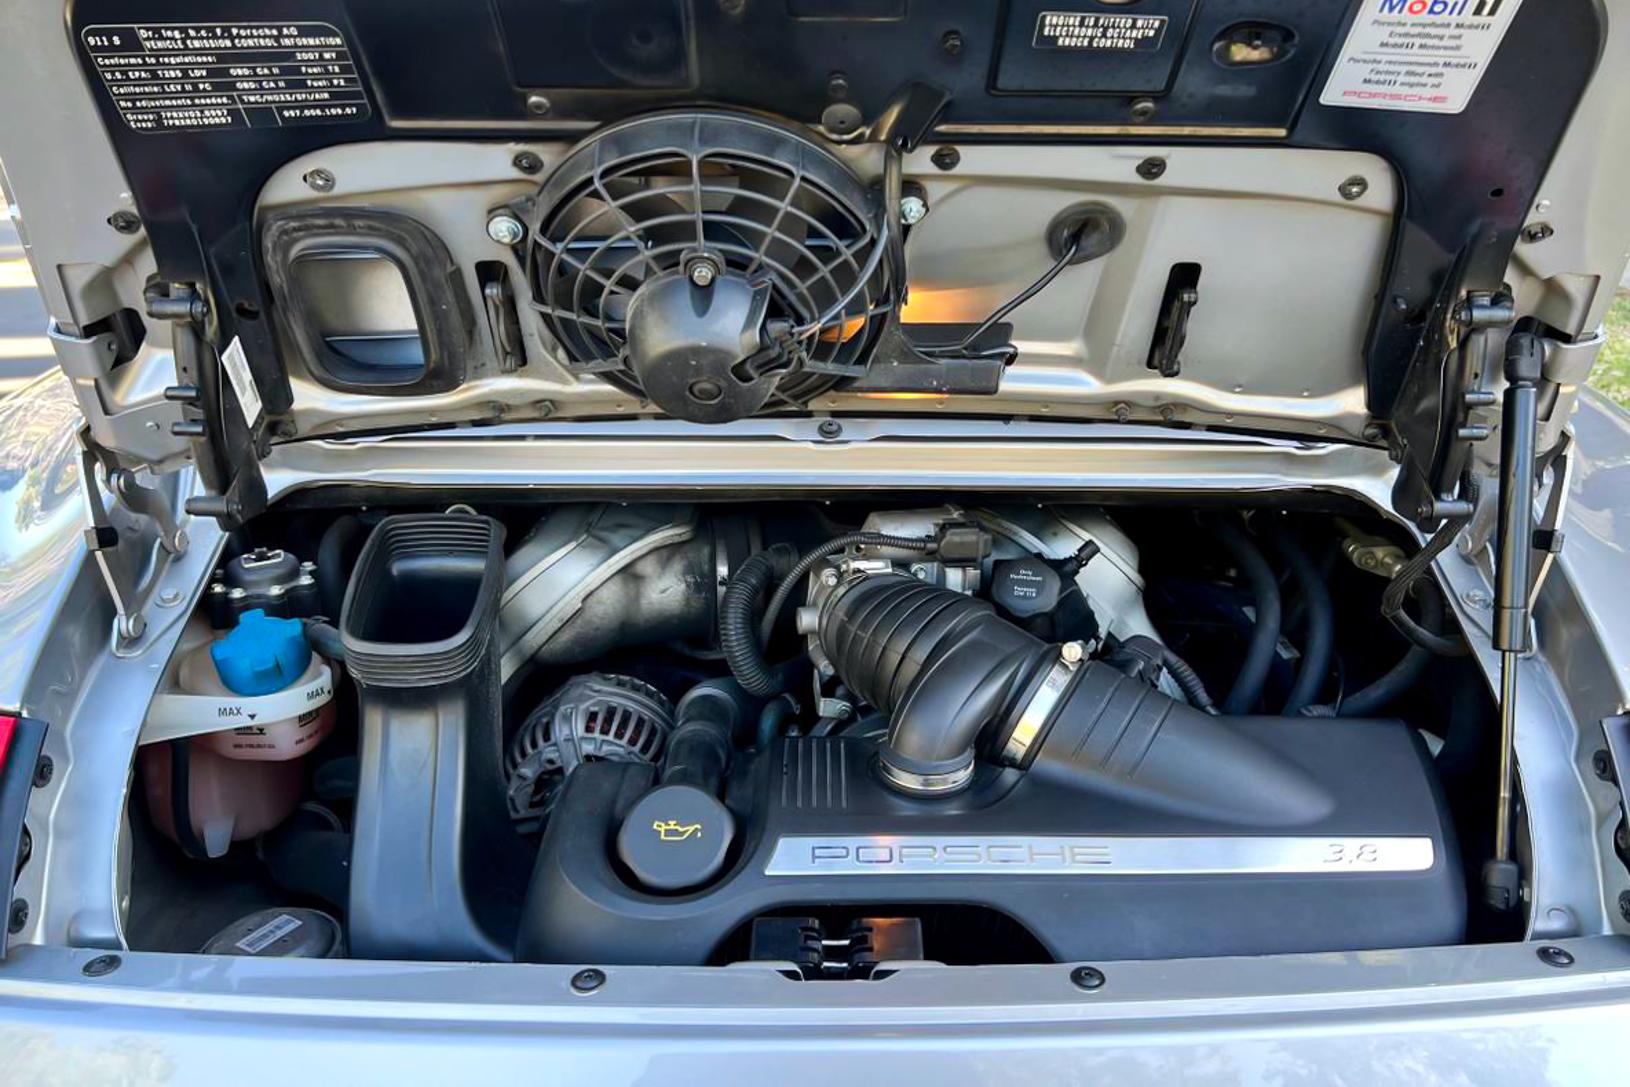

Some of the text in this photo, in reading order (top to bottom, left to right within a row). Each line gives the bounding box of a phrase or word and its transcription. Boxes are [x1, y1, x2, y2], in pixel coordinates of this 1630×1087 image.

[1379, 0, 1469, 16] Mobil
[1045, 15, 1161, 29] ENGINE IS FITTED WITH
[1372, 19, 1407, 27] Porsche
[140, 28, 159, 38] Dr.
[161, 28, 185, 39] Ing.
[215, 27, 228, 37] F.
[231, 26, 278, 37] Porsche
[282, 26, 298, 36] AG
[1044, 26, 1103, 37] ELECTRONIC
[87, 35, 120, 46] 911 S
[144, 37, 342, 49] VEHICLE EMISSION CONTROL INFORMATION
[1057, 37, 1136, 48] KNOCK CONTROL
[97, 57, 143, 65] Conforms
[145, 56, 156, 64] to
[295, 51, 337, 60] 2007 MY
[1347, 57, 1382, 65] Porsche
[1384, 60, 1440, 69] recommends
[104, 70, 126, 80] U.S.
[1368, 68, 1445, 79] Factory filled with
[164, 84, 182, 93] LEV
[1399, 80, 1428, 89] engine
[1430, 81, 1443, 89] oil
[1343, 90, 1449, 103] PORSCHE
[119, 100, 133, 108] No
[136, 98, 192, 108] adjustments
[306, 686, 326, 701] MAX
[218, 706, 243, 718] MAX
[811, 845, 1112, 864] PORSCHE
[1322, 843, 1378, 865] 3.8
